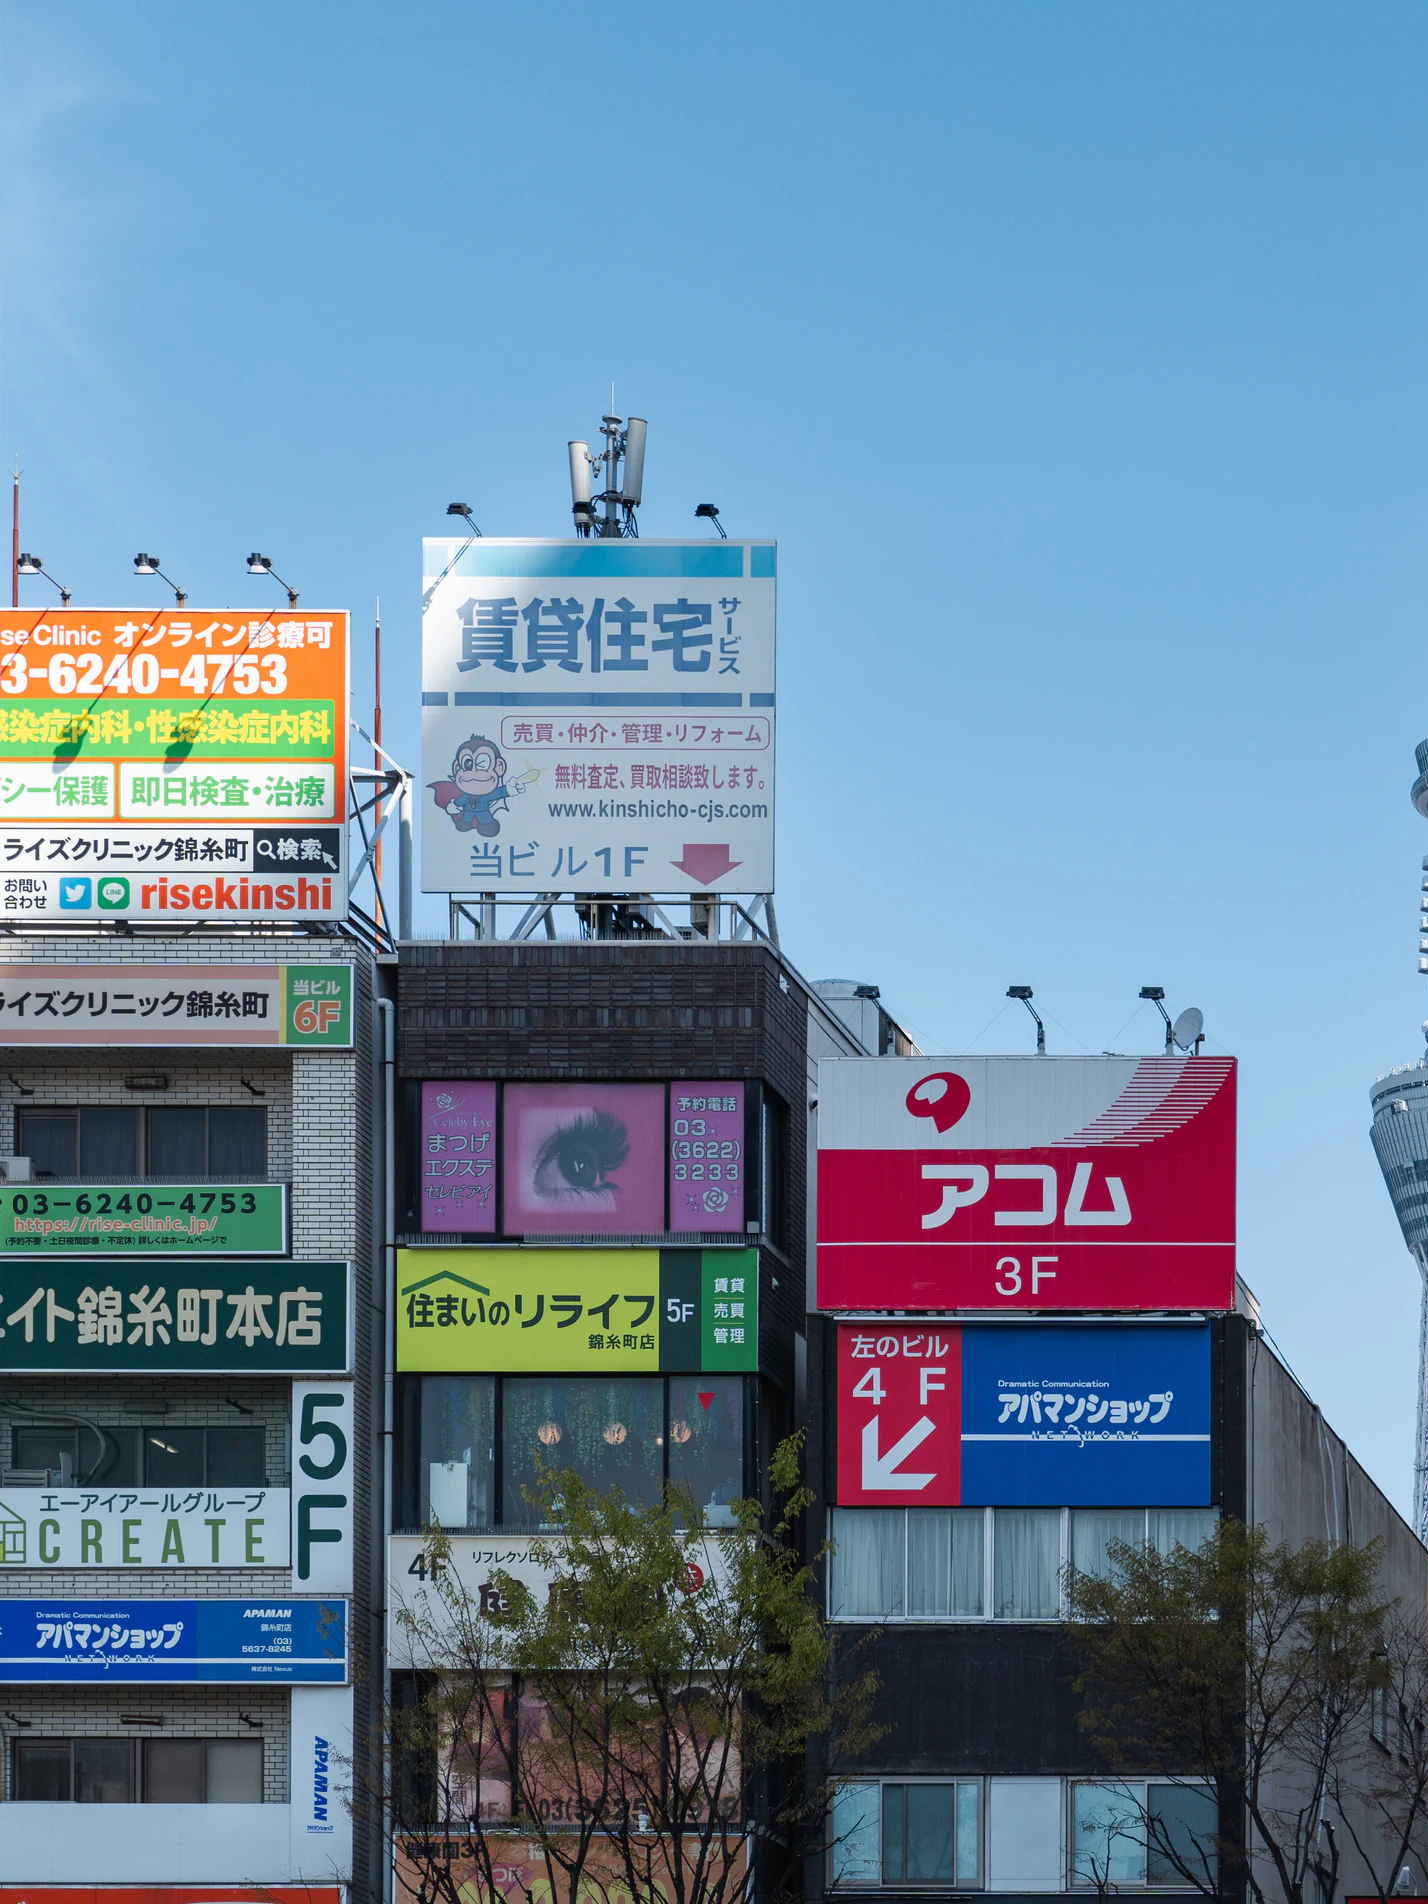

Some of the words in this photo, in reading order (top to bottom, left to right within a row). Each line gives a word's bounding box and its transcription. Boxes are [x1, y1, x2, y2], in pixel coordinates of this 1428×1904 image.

[33, 624, 102, 646] Clinic
[114, 621, 333, 649] オンライン診療可
[456, 597, 713, 674] 賃貸住宅
[718, 597, 741, 675] サービス
[0, 653, 288, 694] 3-6240-4753
[0, 708, 331, 744] 染症内科・性感染症内科
[512, 722, 762, 744] 売買・仲介・管理・リフォーム
[554, 764, 766, 790] 無料査定、買取相談致します。
[131, 776, 326, 807] 即日検査・治療
[548, 799, 768, 822] www.kinshicho-cjs.com
[4, 836, 249, 863] ライズクリニック錦糸町
[277, 837, 322, 860] 検索
[469, 840, 649, 879] 当ビル1F
[4, 879, 47, 893] お問い
[105, 888, 122, 896] LINE
[141, 877, 332, 910] risekinshi
[4, 895, 47, 910] 合わせ
[293, 979, 342, 996] 当ビル
[0, 990, 270, 1019] イズクリニック錦糸町
[293, 1000, 341, 1034] 6F
[676, 1097, 737, 1112] 予約電話
[472, 1116, 493, 1130] Eye
[673, 1119, 707, 1137] 03
[427, 1132, 490, 1153] まつげ
[671, 1139, 742, 1160] (3622)
[425, 1159, 493, 1177] エクステ
[673, 1163, 740, 1181] 3233
[12, 1193, 258, 1215] 03-6240-4753
[922, 1162, 1132, 1229] アコム
[14, 1215, 219, 1236] https://rise-clinic.jp/
[713, 1277, 745, 1294] 賃貸
[995, 1256, 1059, 1296] 3F
[0, 1285, 323, 1347] イト錦糸町本店
[406, 1293, 655, 1330] 住まいのリライフ
[666, 1298, 695, 1324] 5F
[713, 1302, 745, 1319] 売買
[588, 1333, 655, 1350] 錦糸町店
[713, 1327, 745, 1344] 管理
[851, 1334, 949, 1359] 左のビル
[998, 1380, 1039, 1388] Dramatic
[1042, 1380, 1110, 1388] Communication
[998, 1390, 1174, 1424] アパマンショップ
[39, 1491, 266, 1513] エーアイアールグループ
[39, 1518, 266, 1564] CREATE
[243, 1609, 292, 1618] APAMAN
[36, 1621, 184, 1649] アパマンショップ
[261, 1623, 292, 1632] 錦糸町店
[242, 1645, 292, 1653] 5637-8245
[273, 1637, 293, 1645] (03)
[313, 1735, 329, 1821] APAMAN
